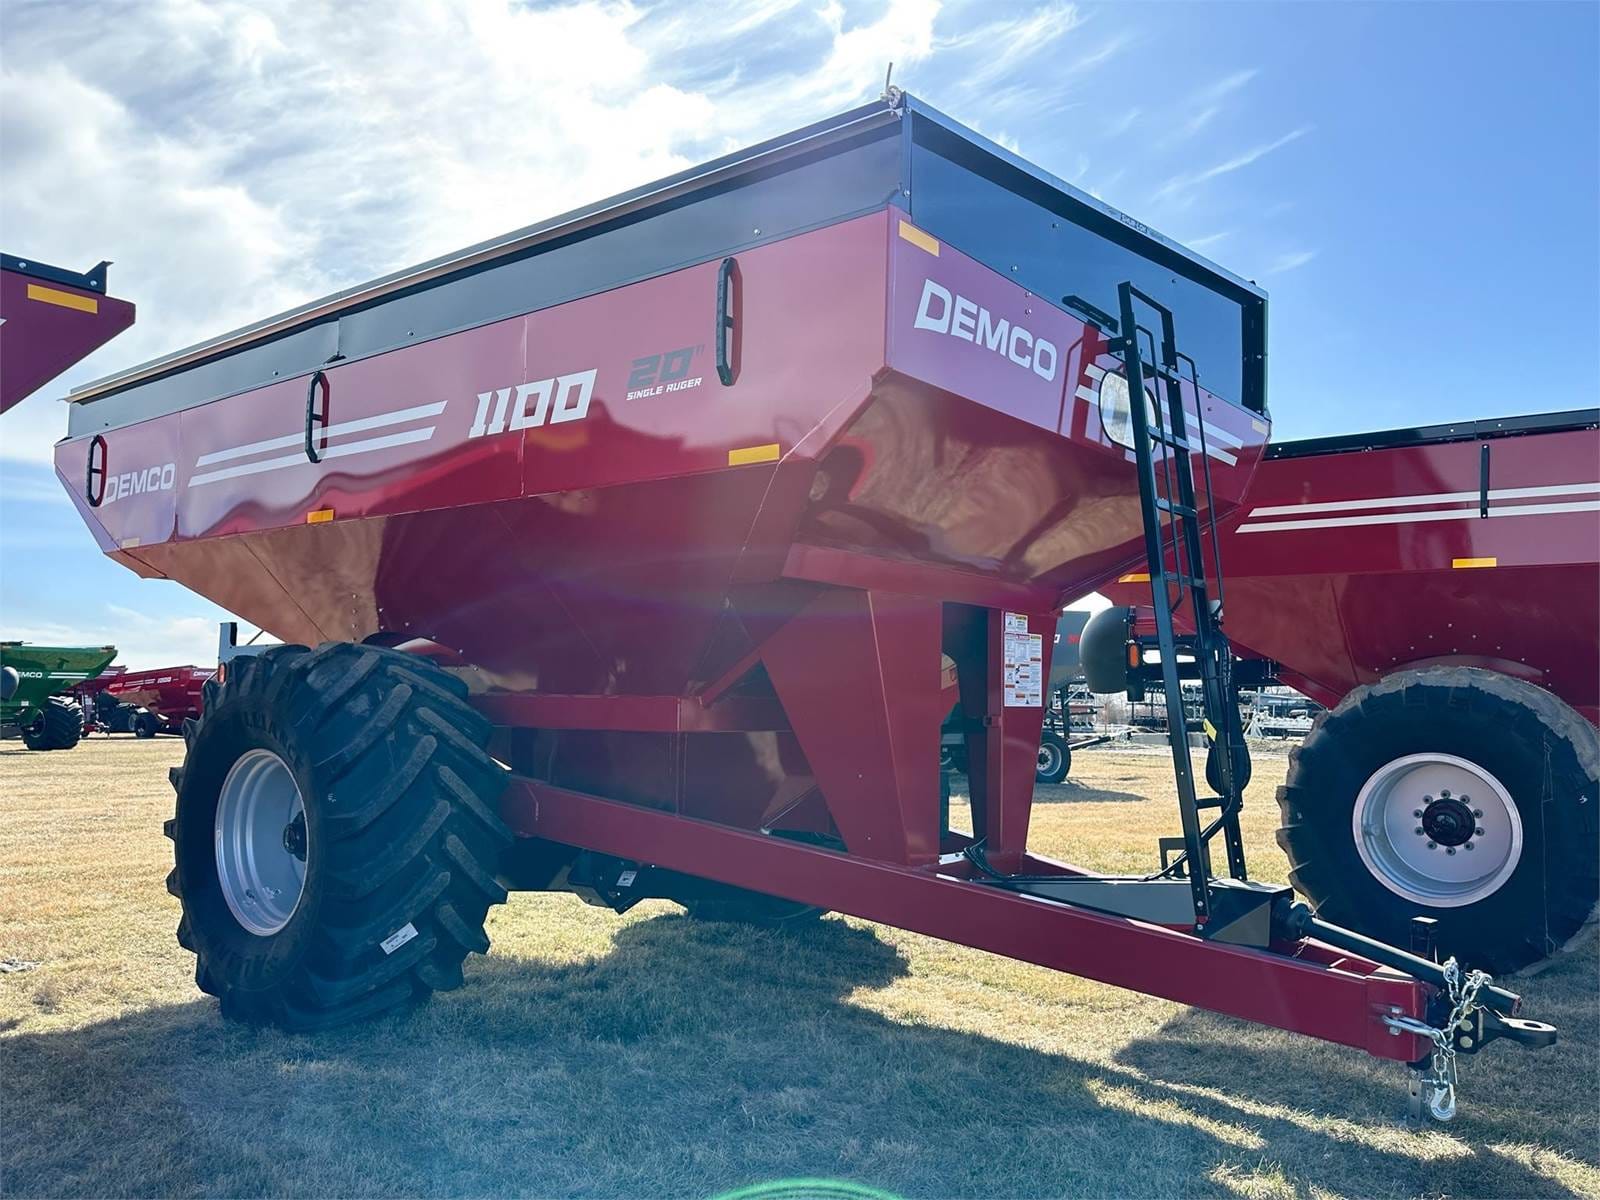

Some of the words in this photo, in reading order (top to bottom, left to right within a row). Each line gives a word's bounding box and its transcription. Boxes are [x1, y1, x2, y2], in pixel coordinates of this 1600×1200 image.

[913, 278, 1057, 382] DEMCO
[468, 368, 598, 439] 1100
[626, 385, 663, 401] SINGLE
[666, 377, 702, 393] AUGER
[101, 463, 175, 508] DEMCO
